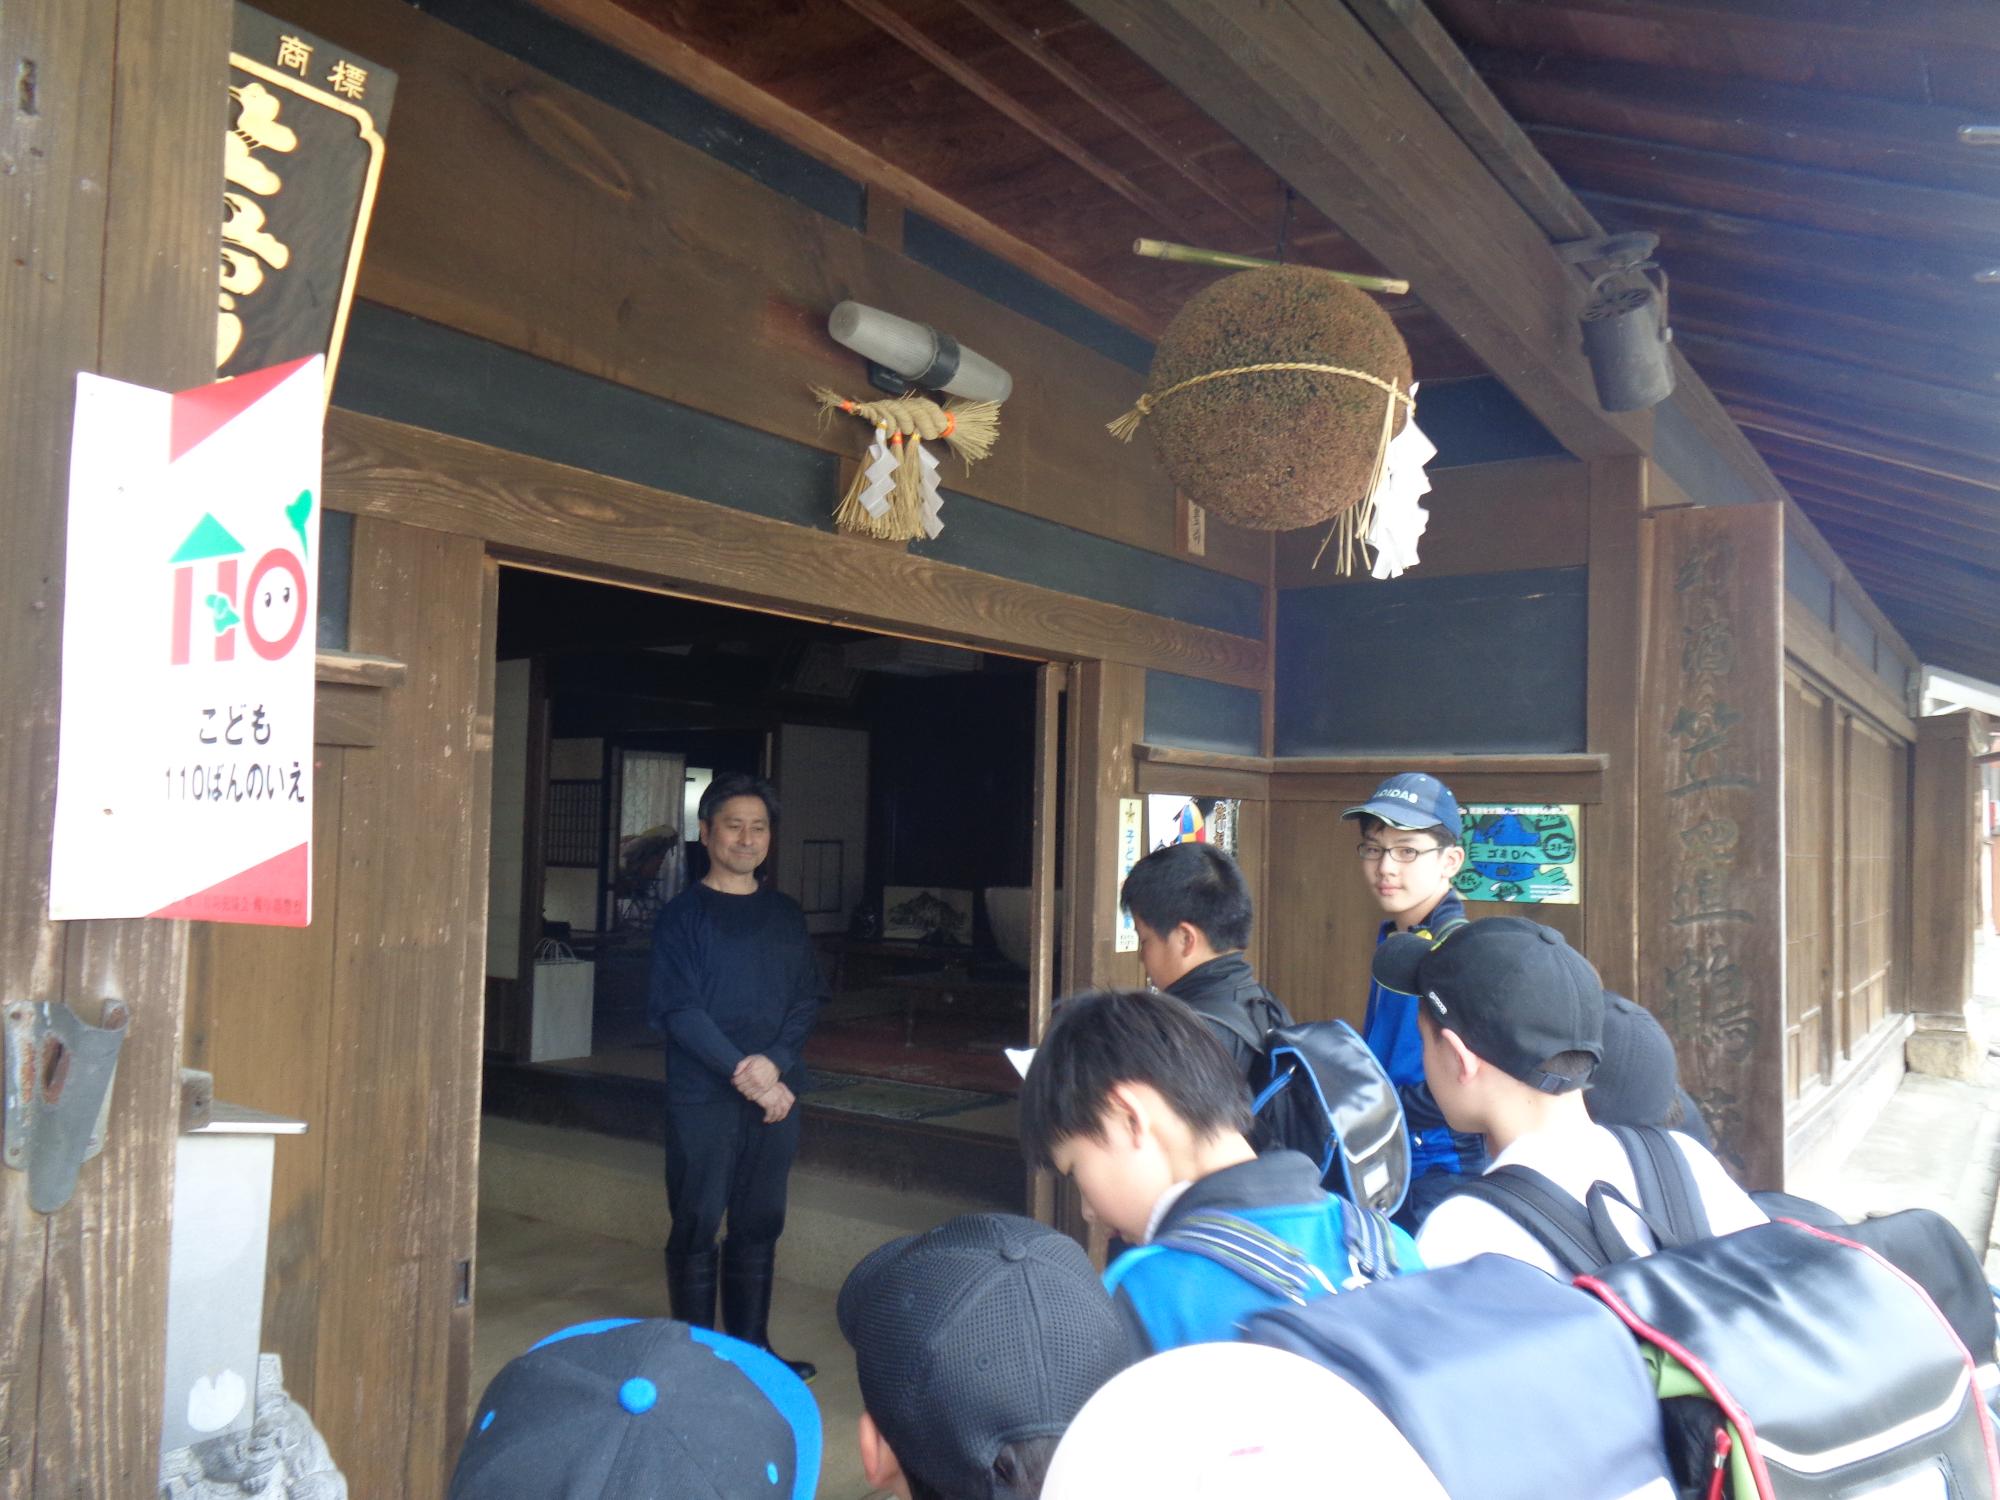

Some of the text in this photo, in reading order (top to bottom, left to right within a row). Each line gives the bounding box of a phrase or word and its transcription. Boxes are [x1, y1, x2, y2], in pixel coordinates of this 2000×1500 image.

[277, 34, 368, 99] 商標
[170, 548, 308, 665] 110
[199, 704, 271, 745] こども
[166, 762, 305, 803] 110ばんのいえ
